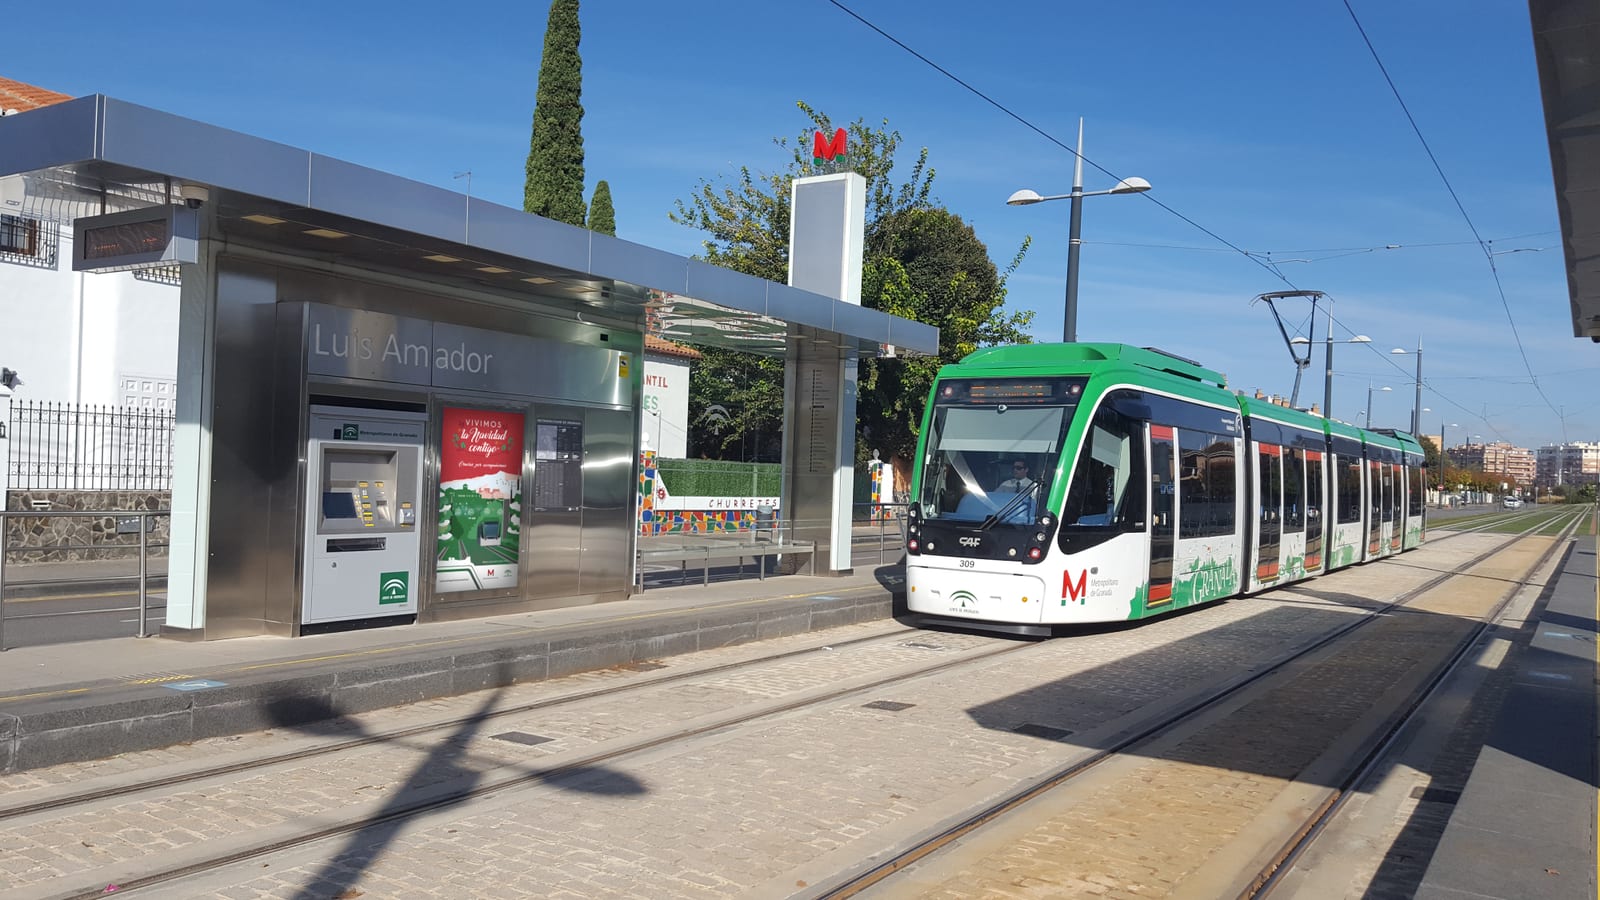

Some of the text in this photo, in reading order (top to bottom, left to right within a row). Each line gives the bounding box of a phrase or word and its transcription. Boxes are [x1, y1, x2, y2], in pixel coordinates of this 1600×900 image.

[813, 128, 847, 166] M
[315, 323, 493, 374] Luis Amador
[466, 419, 502, 428] VIVIMOS
[461, 427, 508, 443] la Navidad
[468, 442, 499, 458] contigo
[959, 536, 981, 547] CAF
[959, 560, 975, 568] 309
[1061, 569, 1087, 606] M
